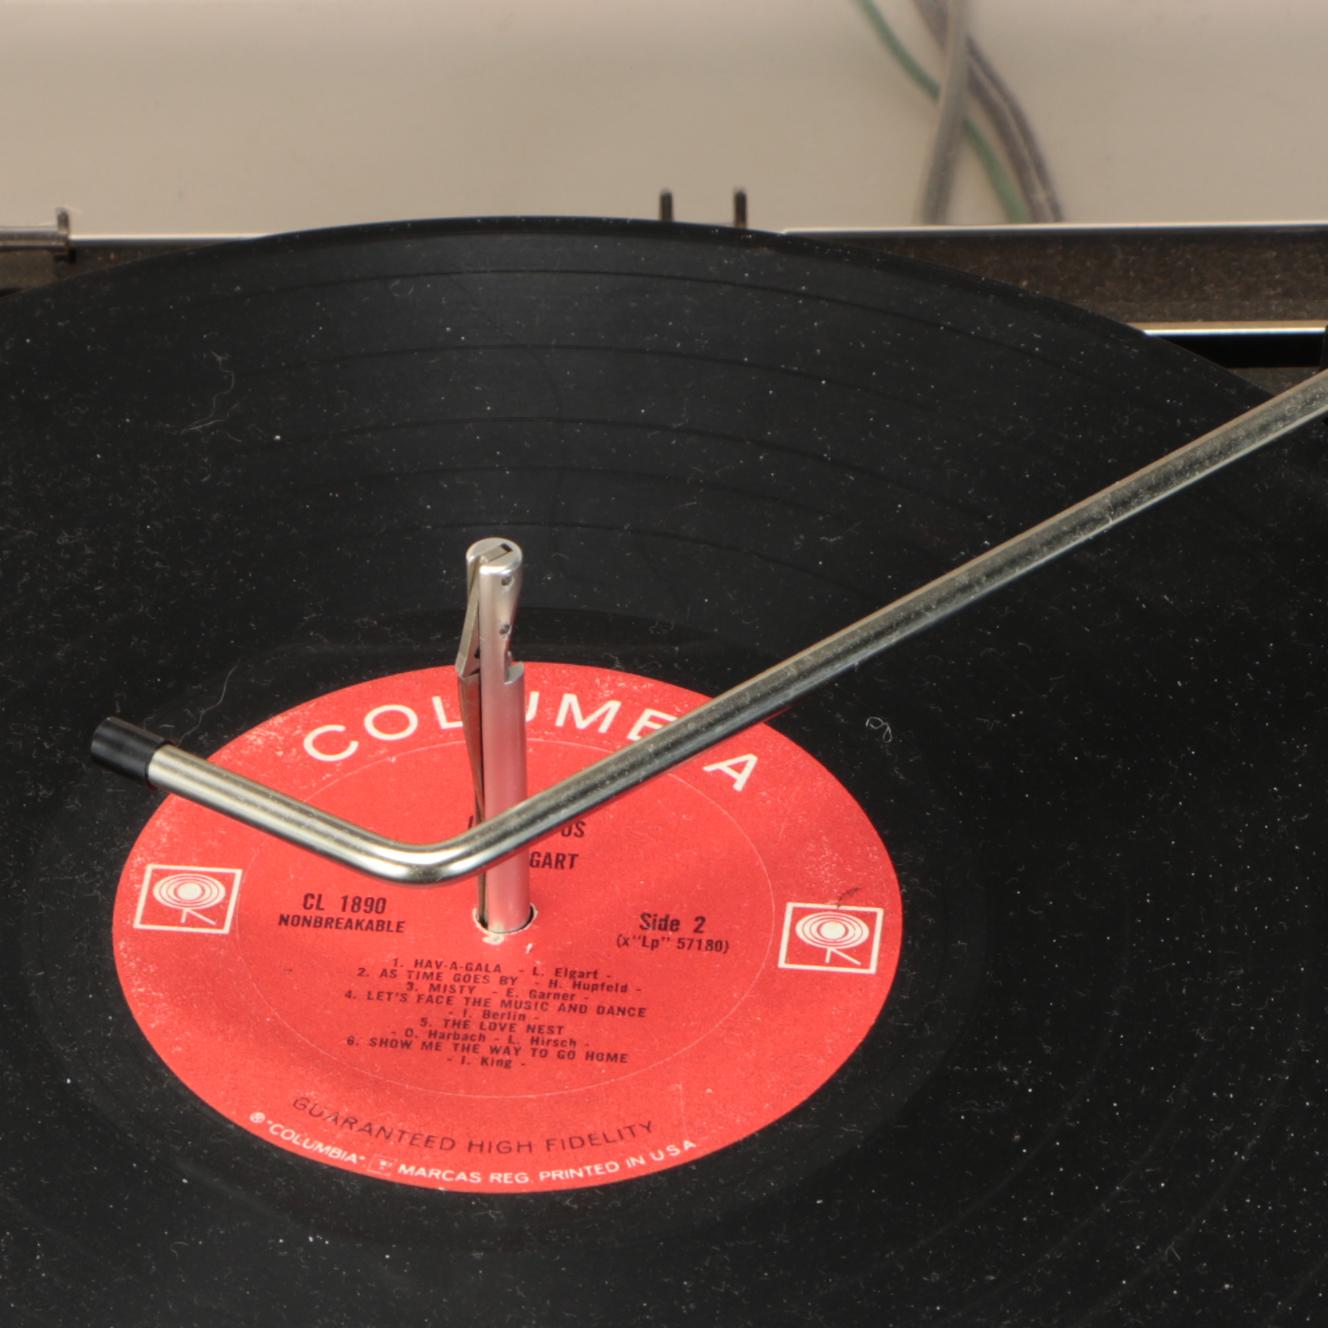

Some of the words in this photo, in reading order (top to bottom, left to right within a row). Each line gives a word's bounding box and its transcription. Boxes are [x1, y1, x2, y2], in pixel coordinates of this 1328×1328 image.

[529, 851, 579, 870] GART
[302, 892, 325, 911] CL
[340, 894, 388, 915] 1890
[278, 914, 405, 933] NONBREAKABLE
[639, 912, 681, 932] Side
[693, 915, 707, 934] 2
[677, 937, 730, 954] 57180)
[393, 958, 404, 968] 1.
[414, 958, 501, 973] HAV-A-GALA
[532, 967, 544, 976] L.
[554, 967, 599, 980] Elgart
[357, 967, 369, 977] 2.
[379, 968, 398, 979] AS
[407, 970, 444, 981] TIME
[453, 973, 491, 984] GOES
[499, 975, 518, 985] BY
[548, 979, 562, 989] H.
[572, 981, 629, 993] Hupfeld
[406, 981, 418, 992] 3.
[428, 983, 477, 995] MISTY
[506, 988, 519, 998] E.
[529, 989, 576, 1001] Garner
[345, 990, 356, 1000] 4.
[367, 991, 409, 1003] LET'S
[416, 994, 454, 1006] FACE
[464, 996, 491, 1008] THE
[500, 999, 549, 1012] MUSIC
[558, 1003, 588, 1014] AND
[596, 1005, 647, 1018] DANCE
[420, 1017, 432, 1027] 5.
[443, 1018, 471, 1030] THE
[479, 1021, 517, 1033] LOVE
[526, 1023, 564, 1035] NEST
[482, 1010, 526, 1022] Berlin
[405, 1028, 418, 1038] O.
[428, 1030, 486, 1042] Harbach
[508, 1035, 520, 1044] L.
[530, 1036, 577, 1048] Hirsch
[346, 1036, 359, 1046] 6.
[369, 1037, 413, 1049] SHOW
[421, 1041, 443, 1051] ME
[453, 1043, 480, 1054] THE
[489, 1045, 521, 1057] WAY
[531, 1047, 548, 1058] TO
[557, 1049, 576, 1060] GO
[585, 1051, 629, 1063] HOME
[480, 1057, 512, 1069] King
[292, 1096, 456, 1151] GUARANTEED
[468, 1140, 533, 1154] HIGH
[546, 1120, 654, 1152] FIDELITY
[398, 1163, 481, 1184] MARCAS
[539, 1160, 621, 1181] PRINTED
[625, 1155, 646, 1168] IN
